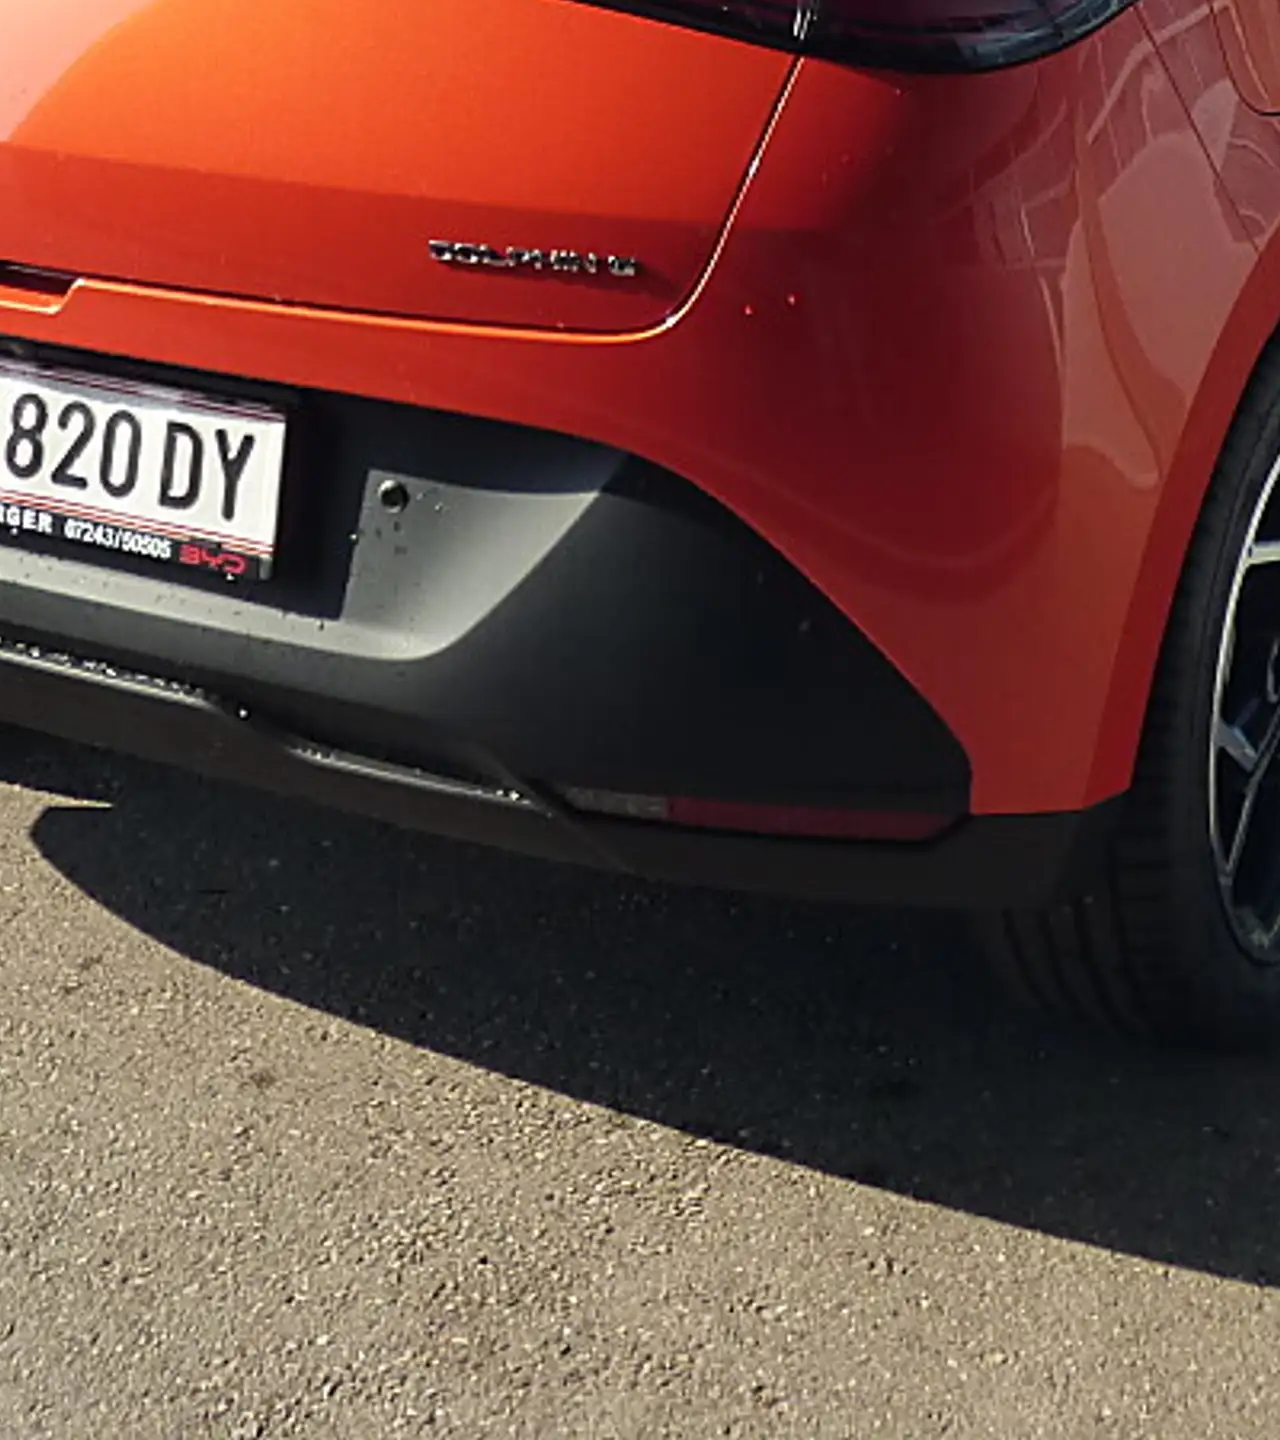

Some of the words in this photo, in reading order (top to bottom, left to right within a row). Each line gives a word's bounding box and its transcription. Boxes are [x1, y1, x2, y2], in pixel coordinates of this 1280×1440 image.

[5, 393, 143, 498] 820
[158, 420, 256, 522] DY
[178, 543, 248, 574] BYD
